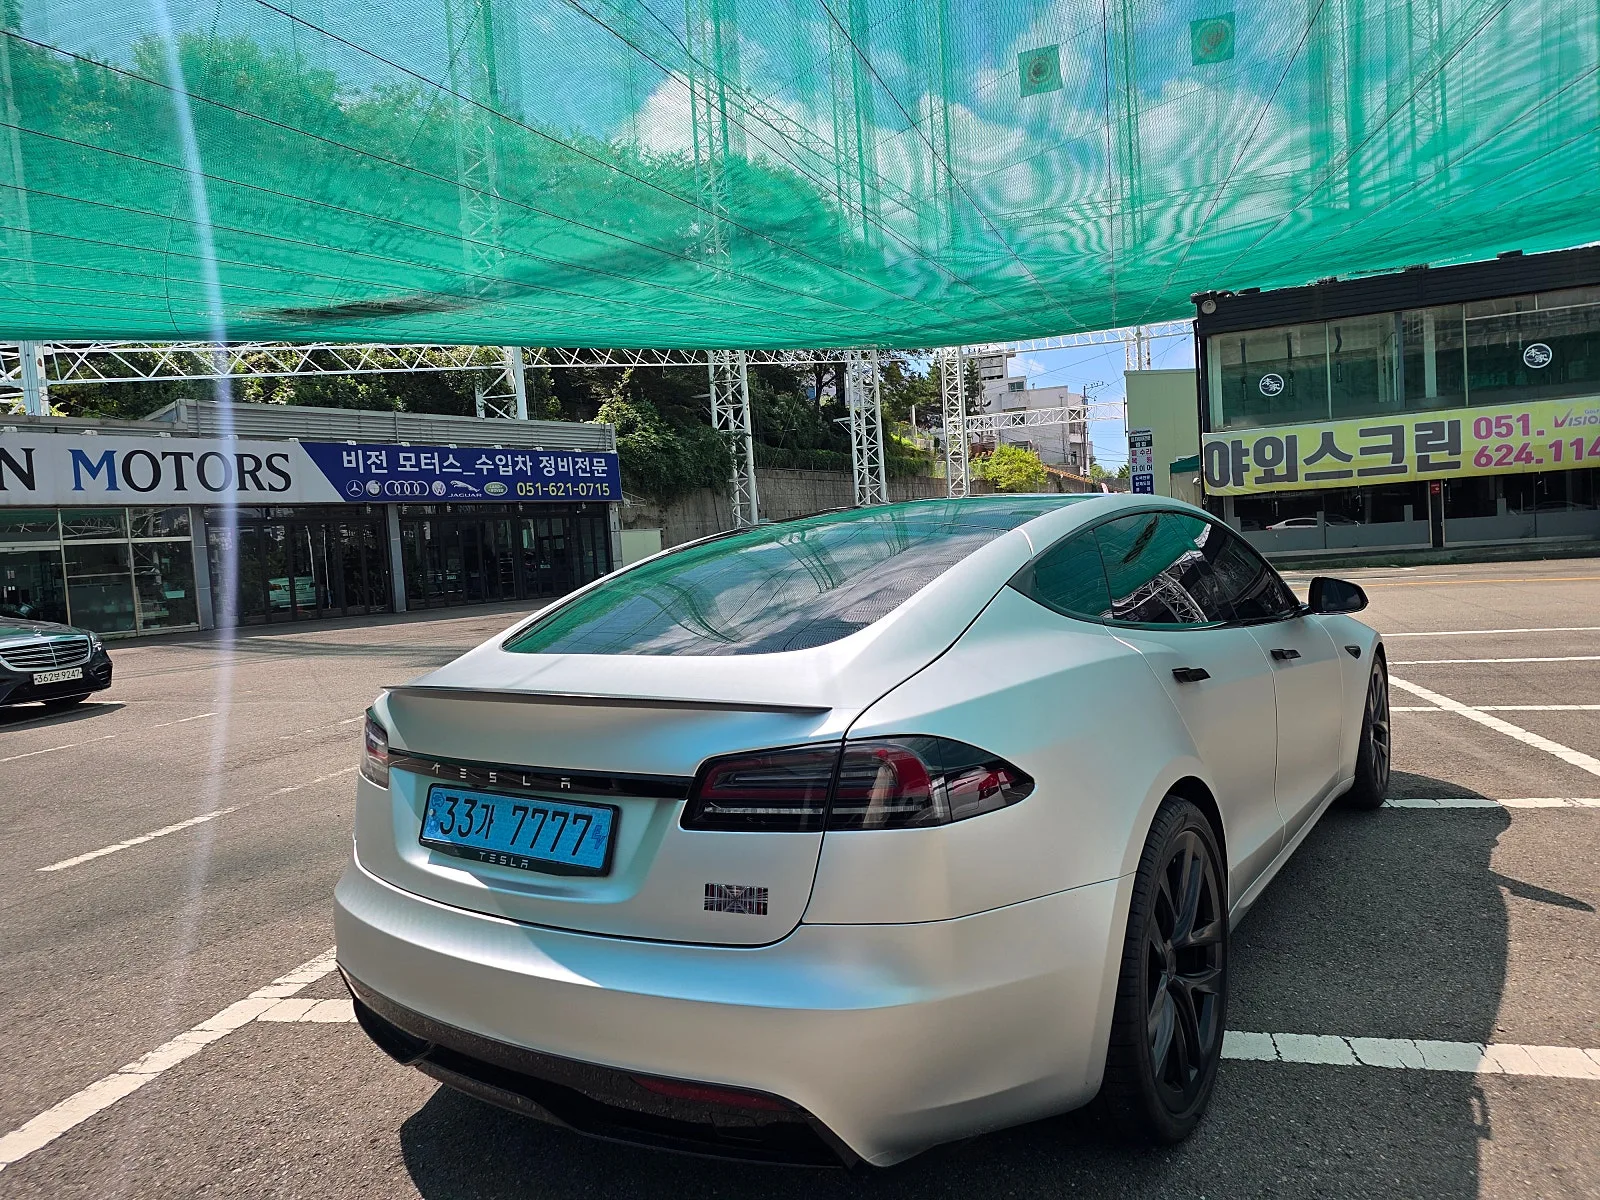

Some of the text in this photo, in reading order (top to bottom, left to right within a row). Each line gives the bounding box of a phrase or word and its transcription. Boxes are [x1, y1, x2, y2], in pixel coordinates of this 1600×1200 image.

[1554, 408, 1600, 428] VISIO
[342, 449, 388, 474] 비전
[538, 455, 608, 477] 정비전문
[1204, 419, 1462, 488] 야외스크린
[68, 448, 292, 493] MOTORS
[516, 482, 610, 496] 051-621-0715
[432, 763, 571, 789] TESLA
[439, 796, 593, 856] 33가 7777
[479, 851, 529, 869] TESLA
